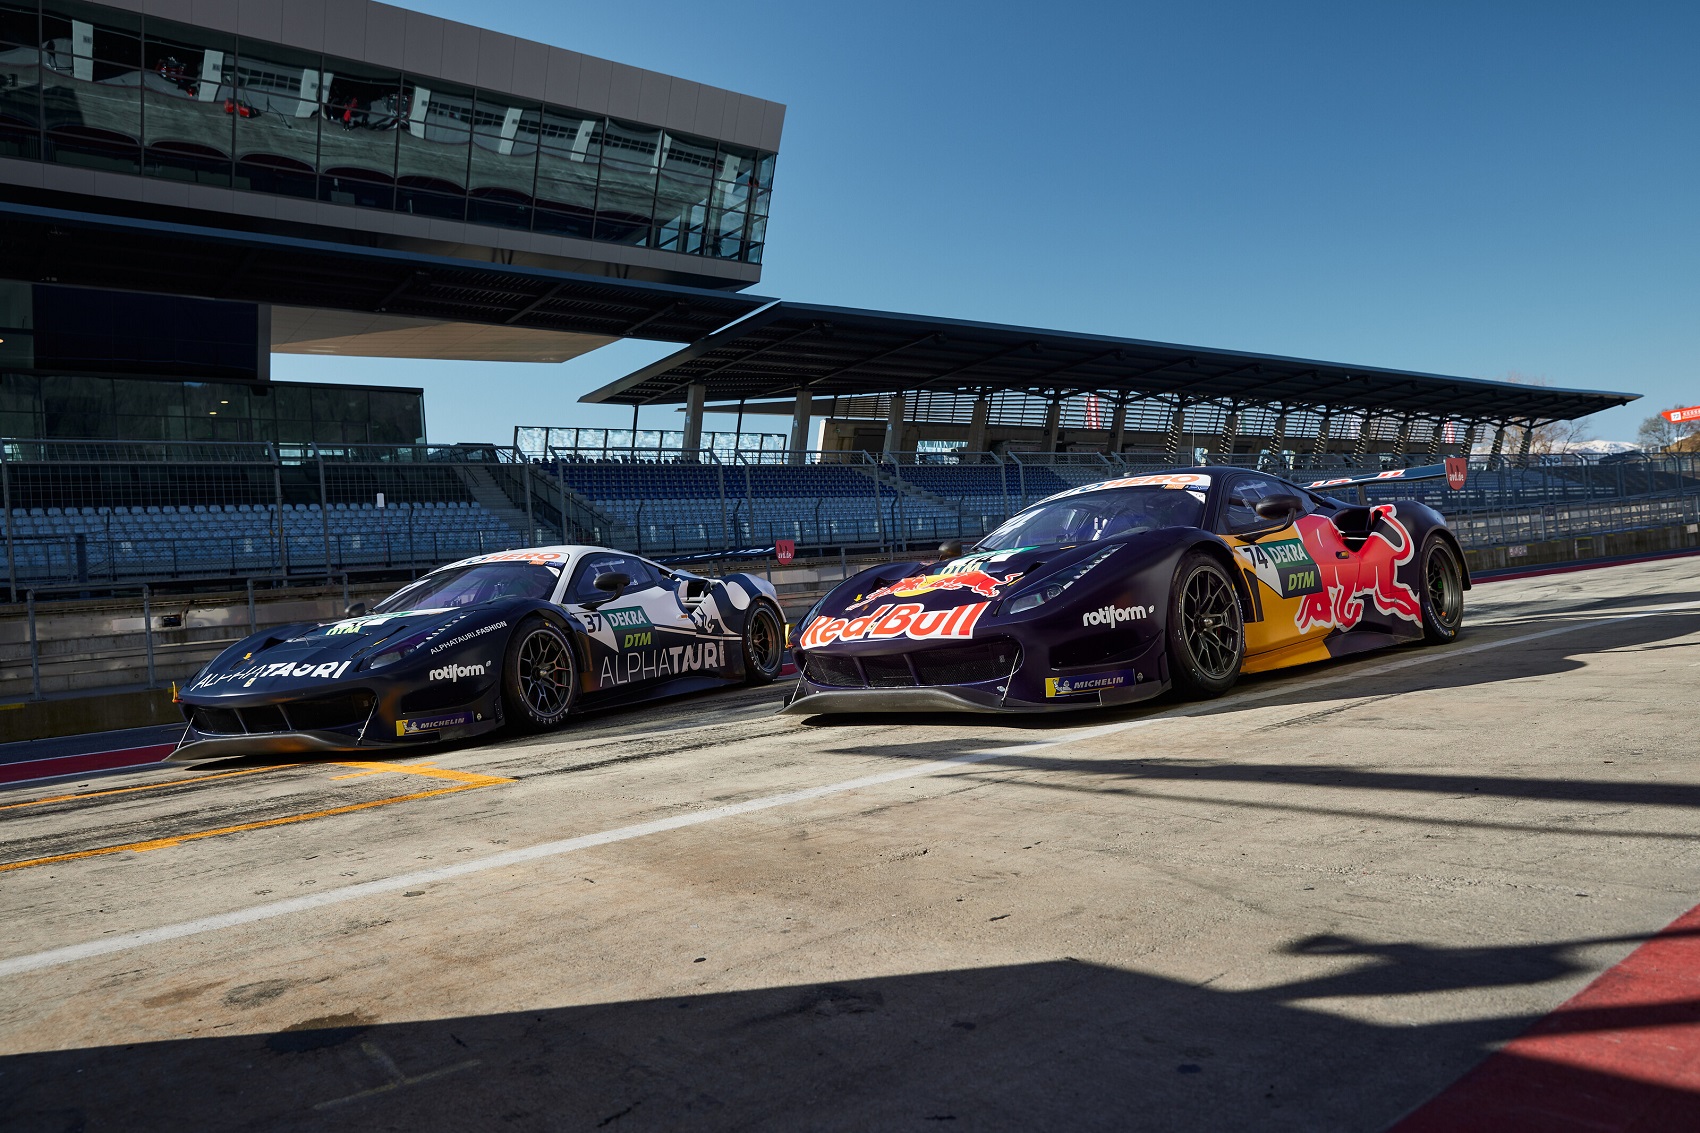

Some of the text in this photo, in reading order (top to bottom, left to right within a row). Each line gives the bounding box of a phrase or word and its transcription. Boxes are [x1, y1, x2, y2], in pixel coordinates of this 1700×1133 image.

[1243, 544, 1269, 569] 74
[1267, 542, 1308, 564] DEKRA
[1287, 570, 1315, 592] DTM
[584, 612, 602, 633] 37
[607, 610, 648, 627] DEKRA
[801, 601, 991, 647] Red Bull
[1082, 604, 1147, 629] rotiform
[430, 620, 508, 655] ALPHATAURI.FASHION
[623, 631, 652, 649] DTM
[429, 663, 485, 683] rotiform
[600, 640, 726, 688] ALPHATAURI
[1073, 676, 1124, 690] MICHELIN
[420, 716, 466, 730] MICHELIN
